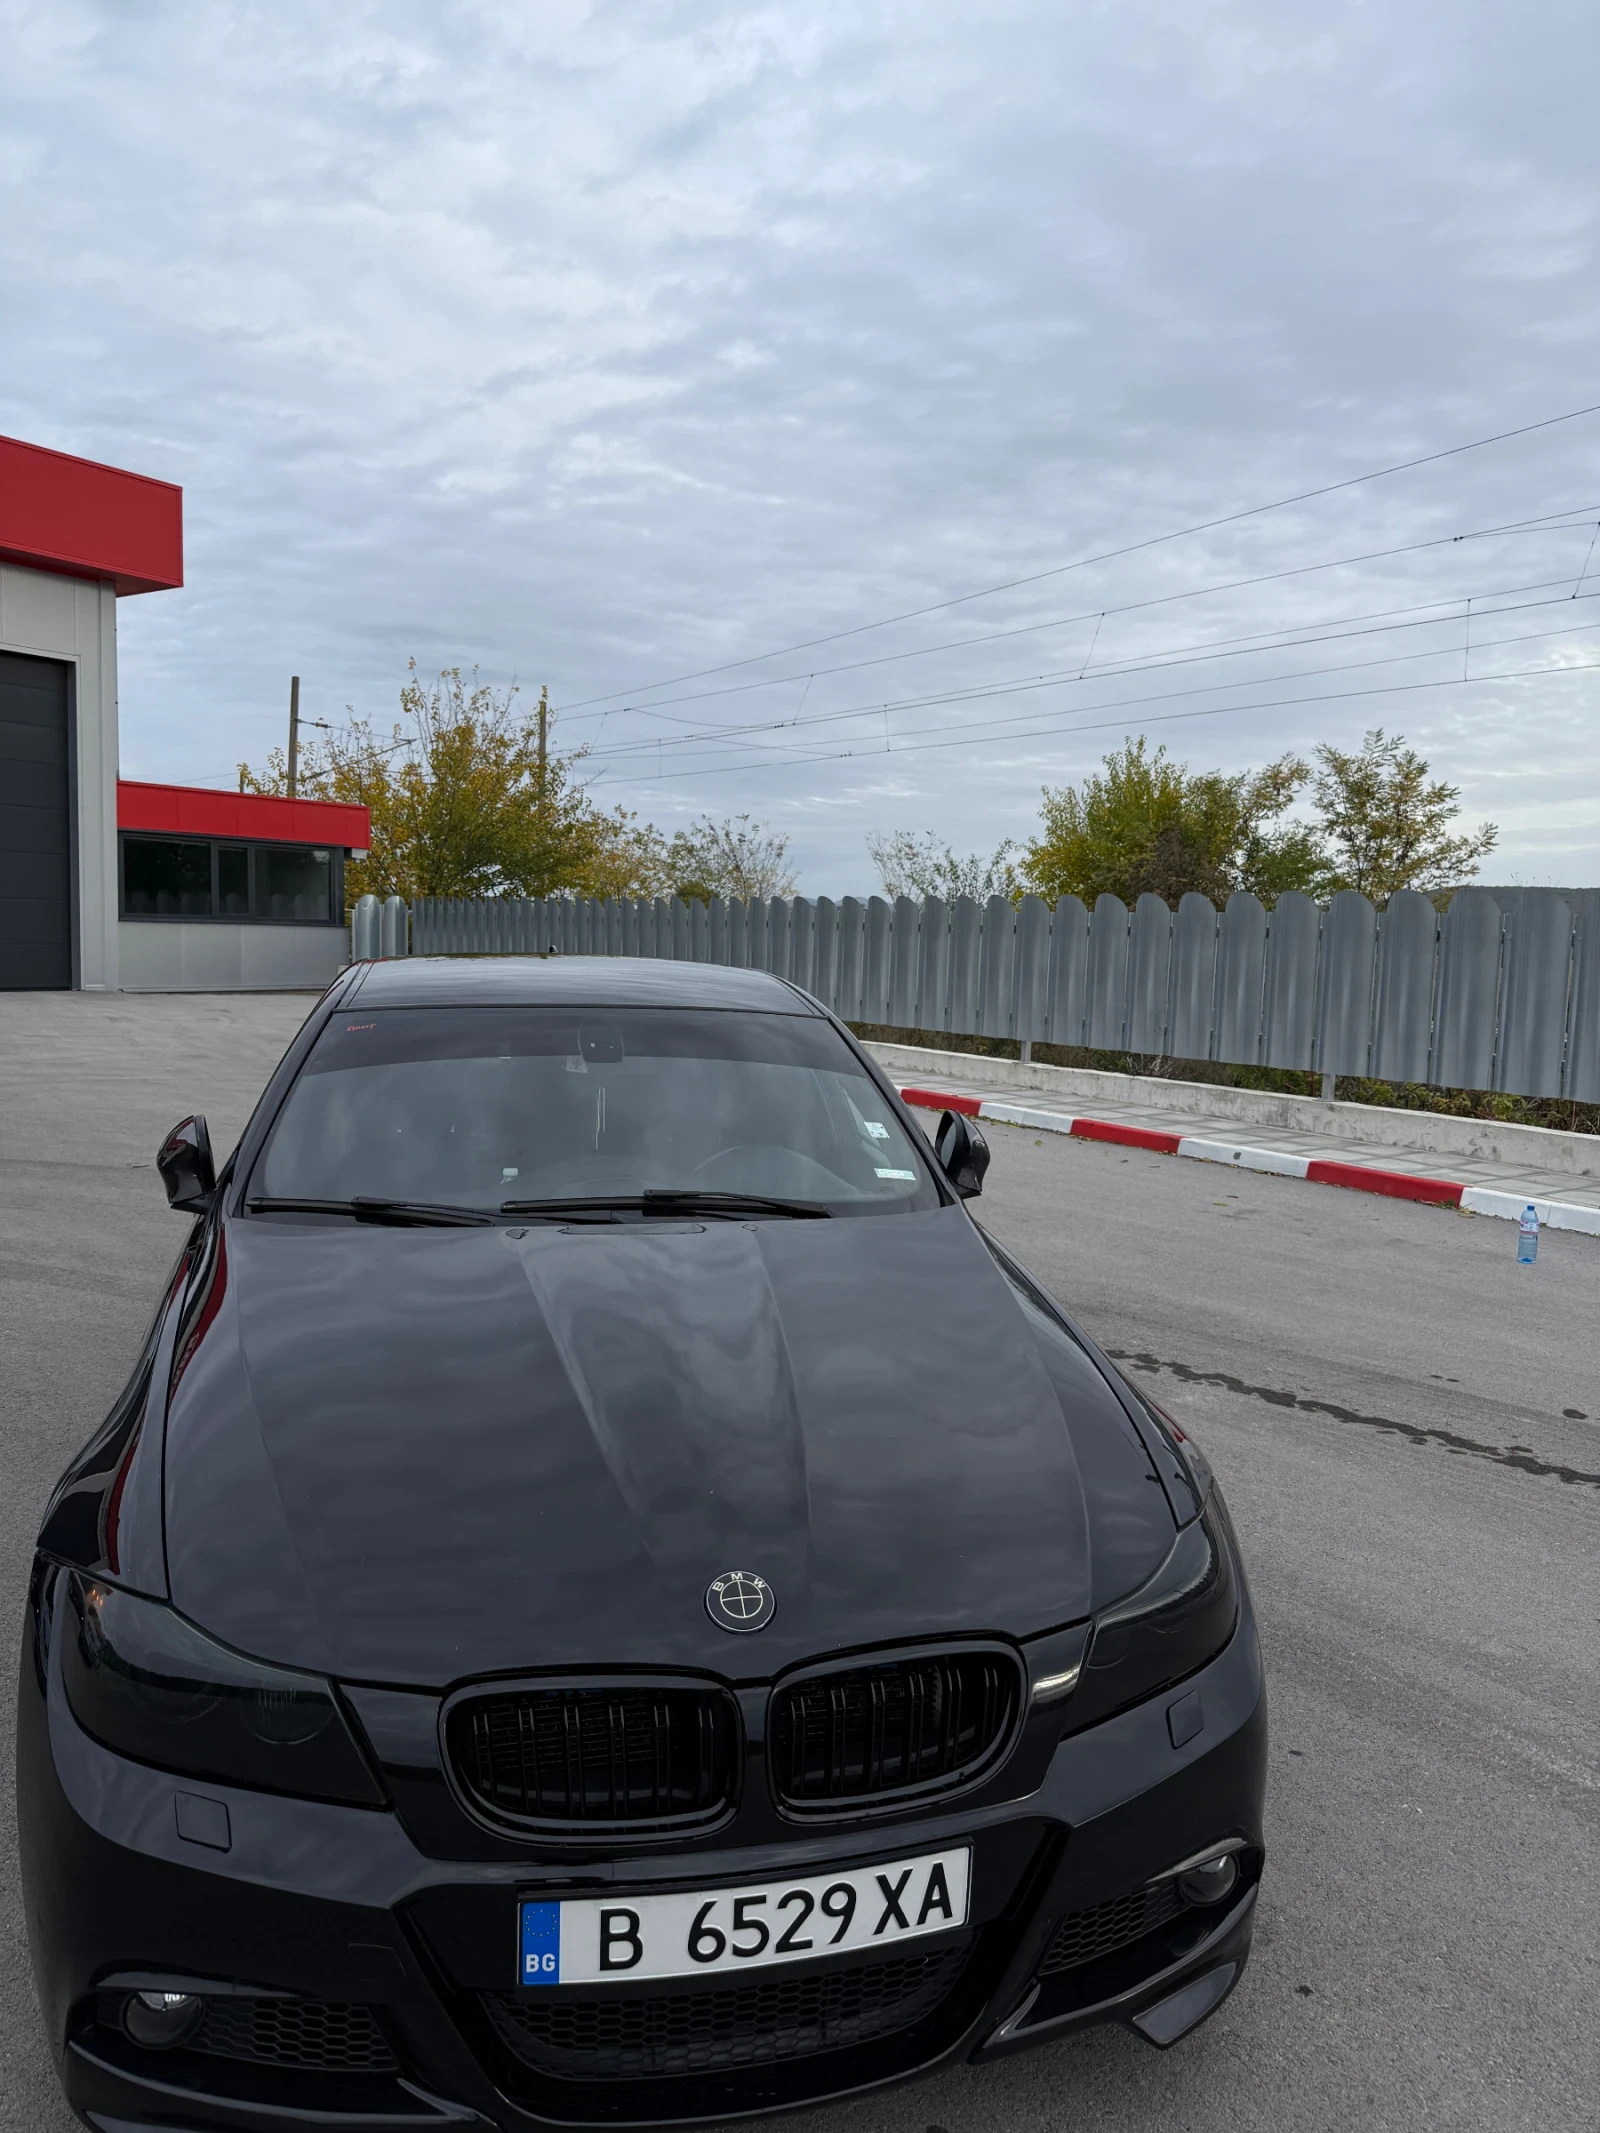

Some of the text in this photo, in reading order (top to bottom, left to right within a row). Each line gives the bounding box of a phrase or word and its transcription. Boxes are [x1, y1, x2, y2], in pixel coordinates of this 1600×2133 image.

[712, 1572, 766, 1592] BMW
[599, 1862, 953, 1972] B 6529 XA
[525, 1953, 556, 1973] BG
